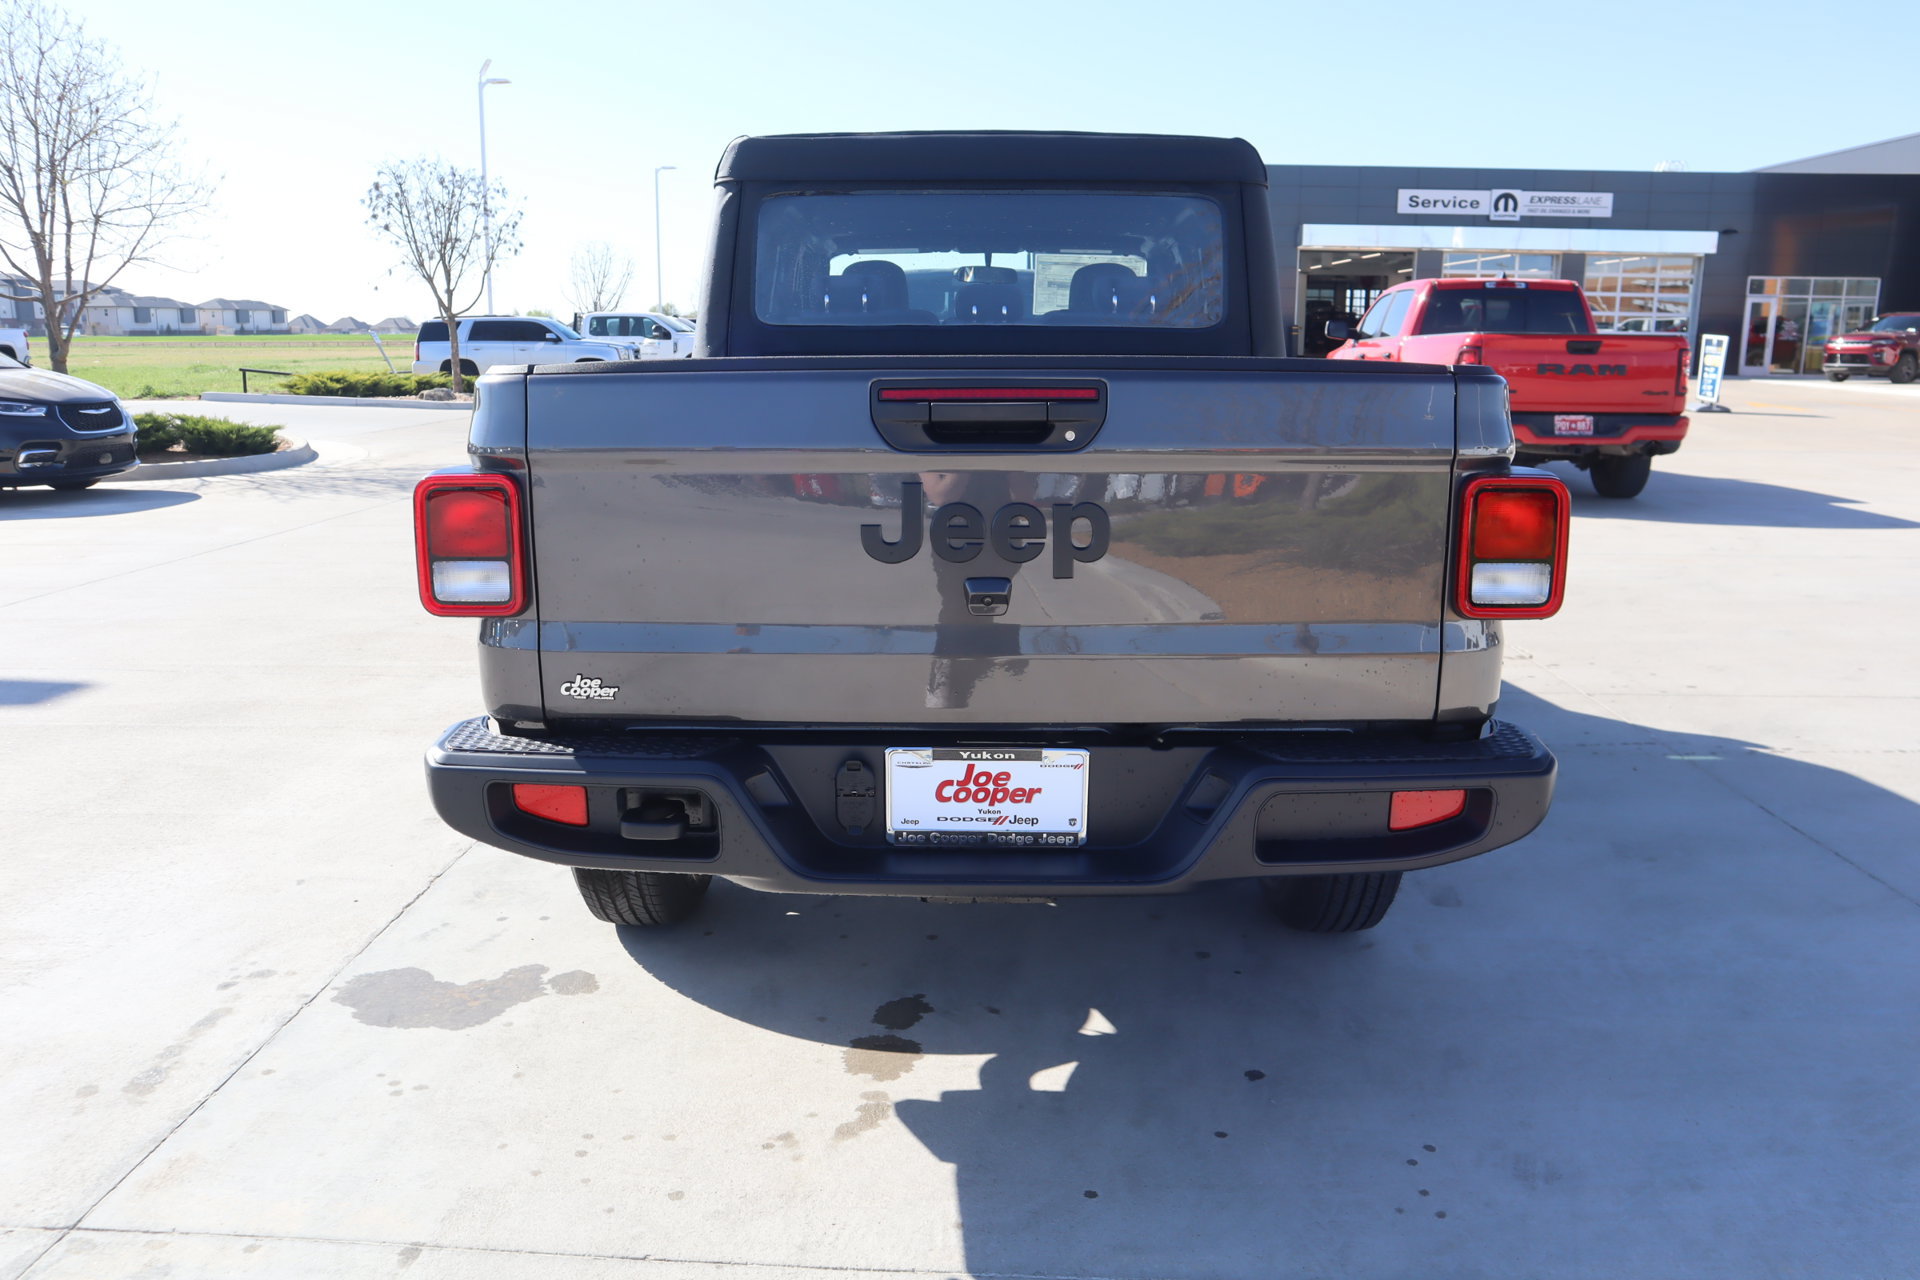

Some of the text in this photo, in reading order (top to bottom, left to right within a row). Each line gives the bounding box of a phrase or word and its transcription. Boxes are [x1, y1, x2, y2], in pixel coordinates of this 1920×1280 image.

[1408, 194, 1480, 209] Service
[1537, 363, 1628, 376] RAM
[860, 481, 1111, 579] Jeep
[571, 674, 602, 688] Joe
[560, 682, 619, 698] Cooper
[959, 751, 1016, 760] Yukon
[956, 763, 1012, 787] Joe
[935, 779, 1043, 807] Cooper
[900, 818, 920, 826] Jeep
[1008, 815, 1039, 826] Jeep
[898, 832, 1075, 846] Joe Cooper Dodge Jeep
